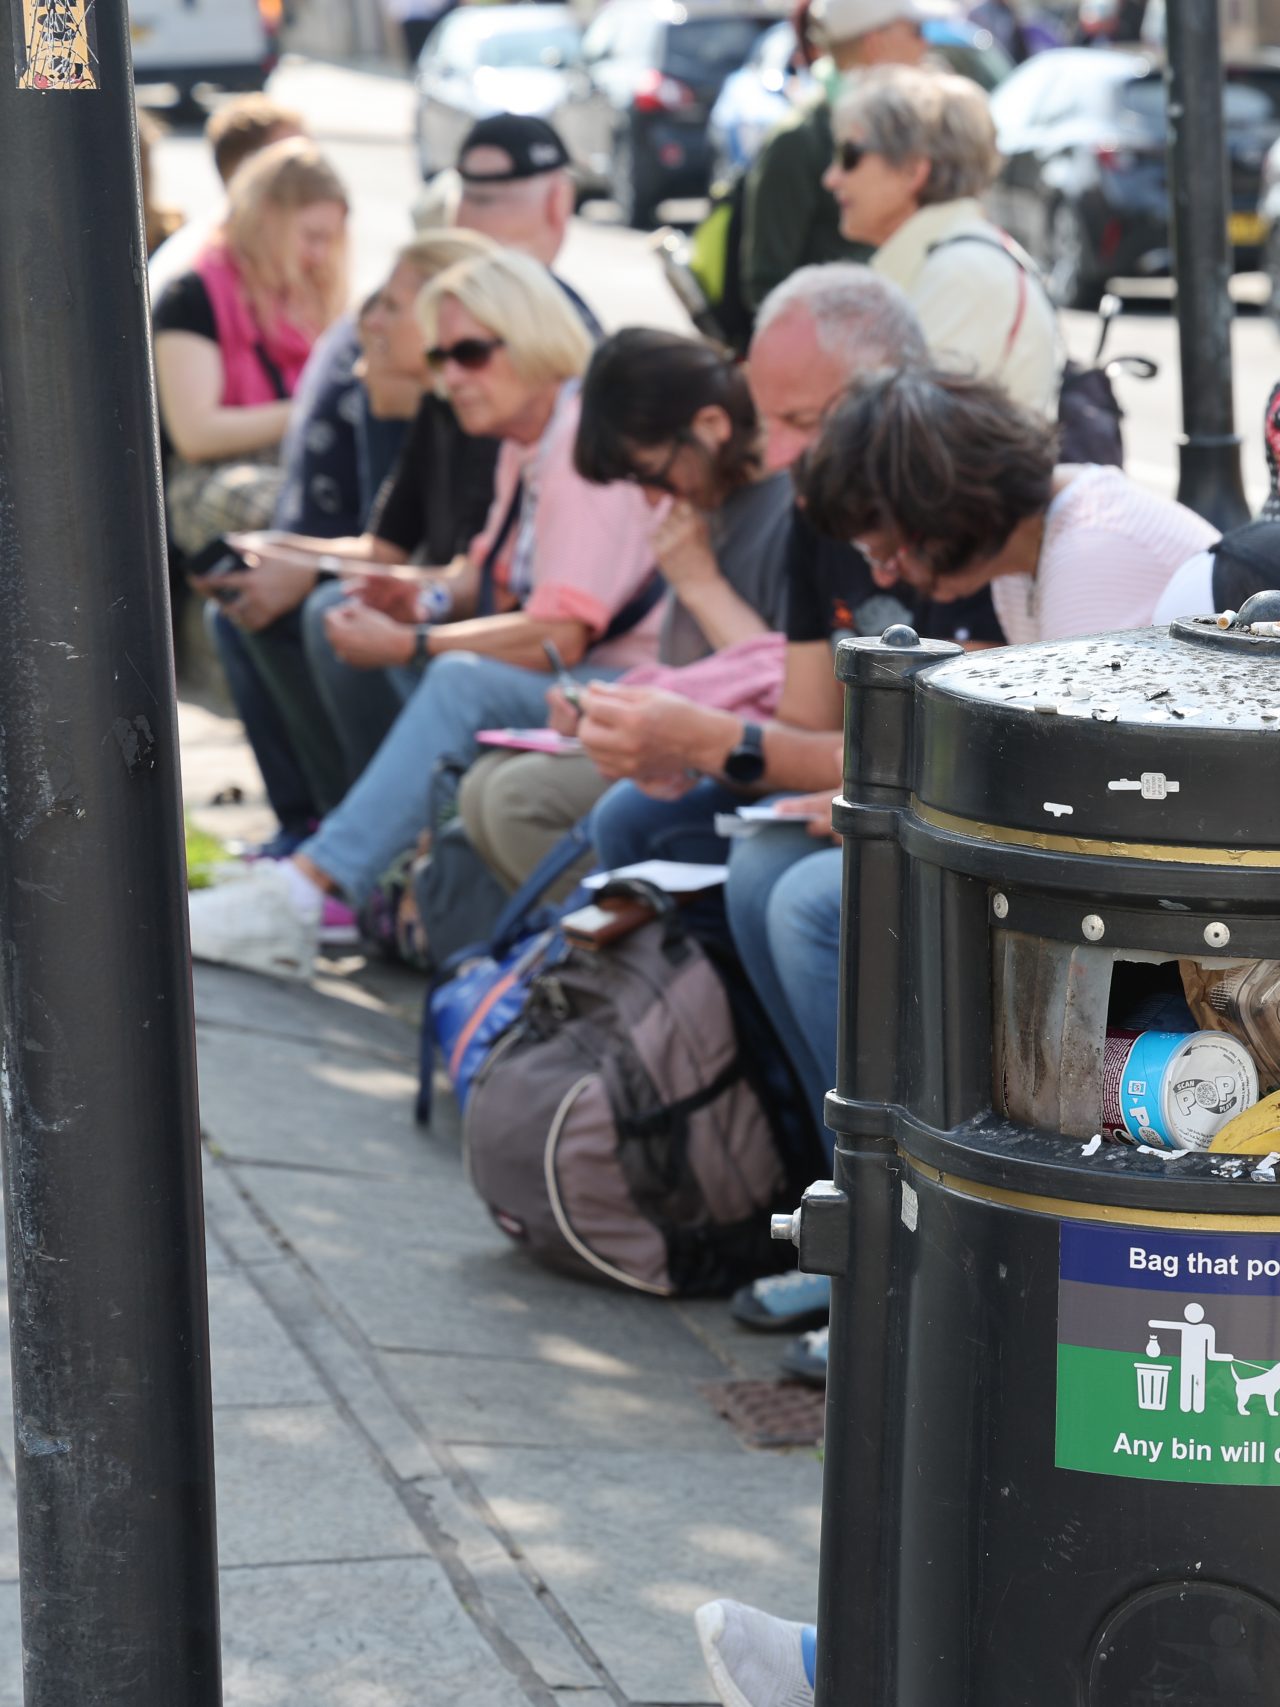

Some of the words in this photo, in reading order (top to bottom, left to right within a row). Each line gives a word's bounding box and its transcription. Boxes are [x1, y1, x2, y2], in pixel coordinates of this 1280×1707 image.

[1176, 1079, 1195, 1091] SCAN
[1219, 1099, 1234, 1113] PLAY
[1129, 1247, 1178, 1278] Bag
[1187, 1252, 1239, 1276] that
[1113, 1432, 1164, 1463] Any
[1171, 1437, 1212, 1462] bin
[1220, 1441, 1266, 1463] will
